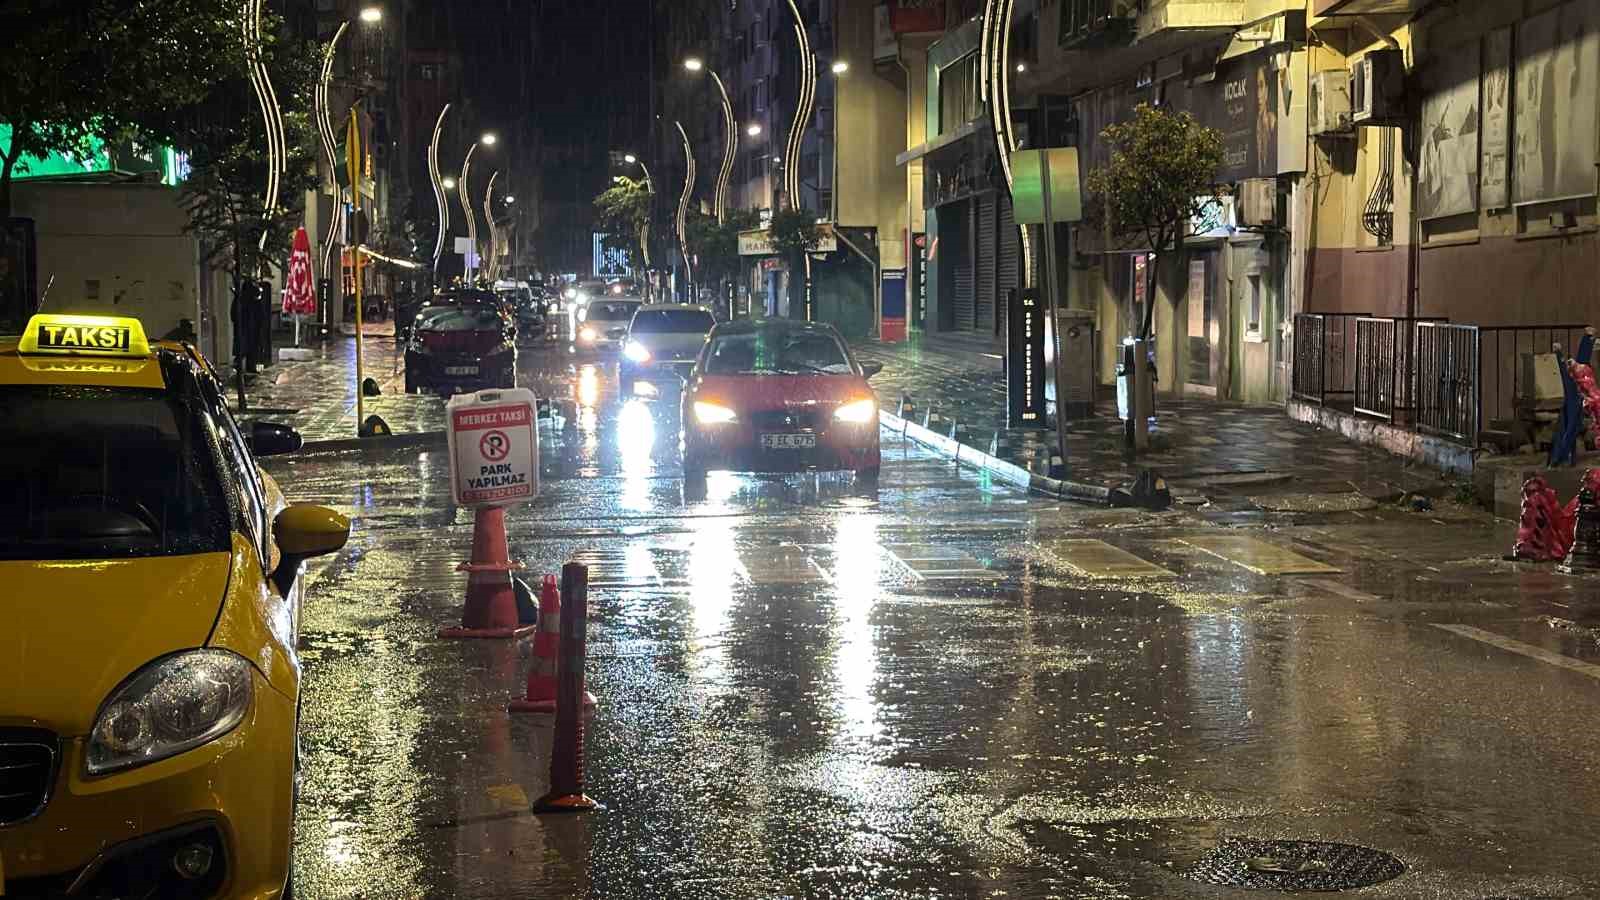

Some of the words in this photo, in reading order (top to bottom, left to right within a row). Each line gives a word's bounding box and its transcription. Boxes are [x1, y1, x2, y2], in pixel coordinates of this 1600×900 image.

[44, 326, 126, 348] TAKSİ
[459, 413, 497, 425] MERKEZ
[480, 463, 511, 475] PARK
[467, 473, 526, 489] YAPILMAZ
